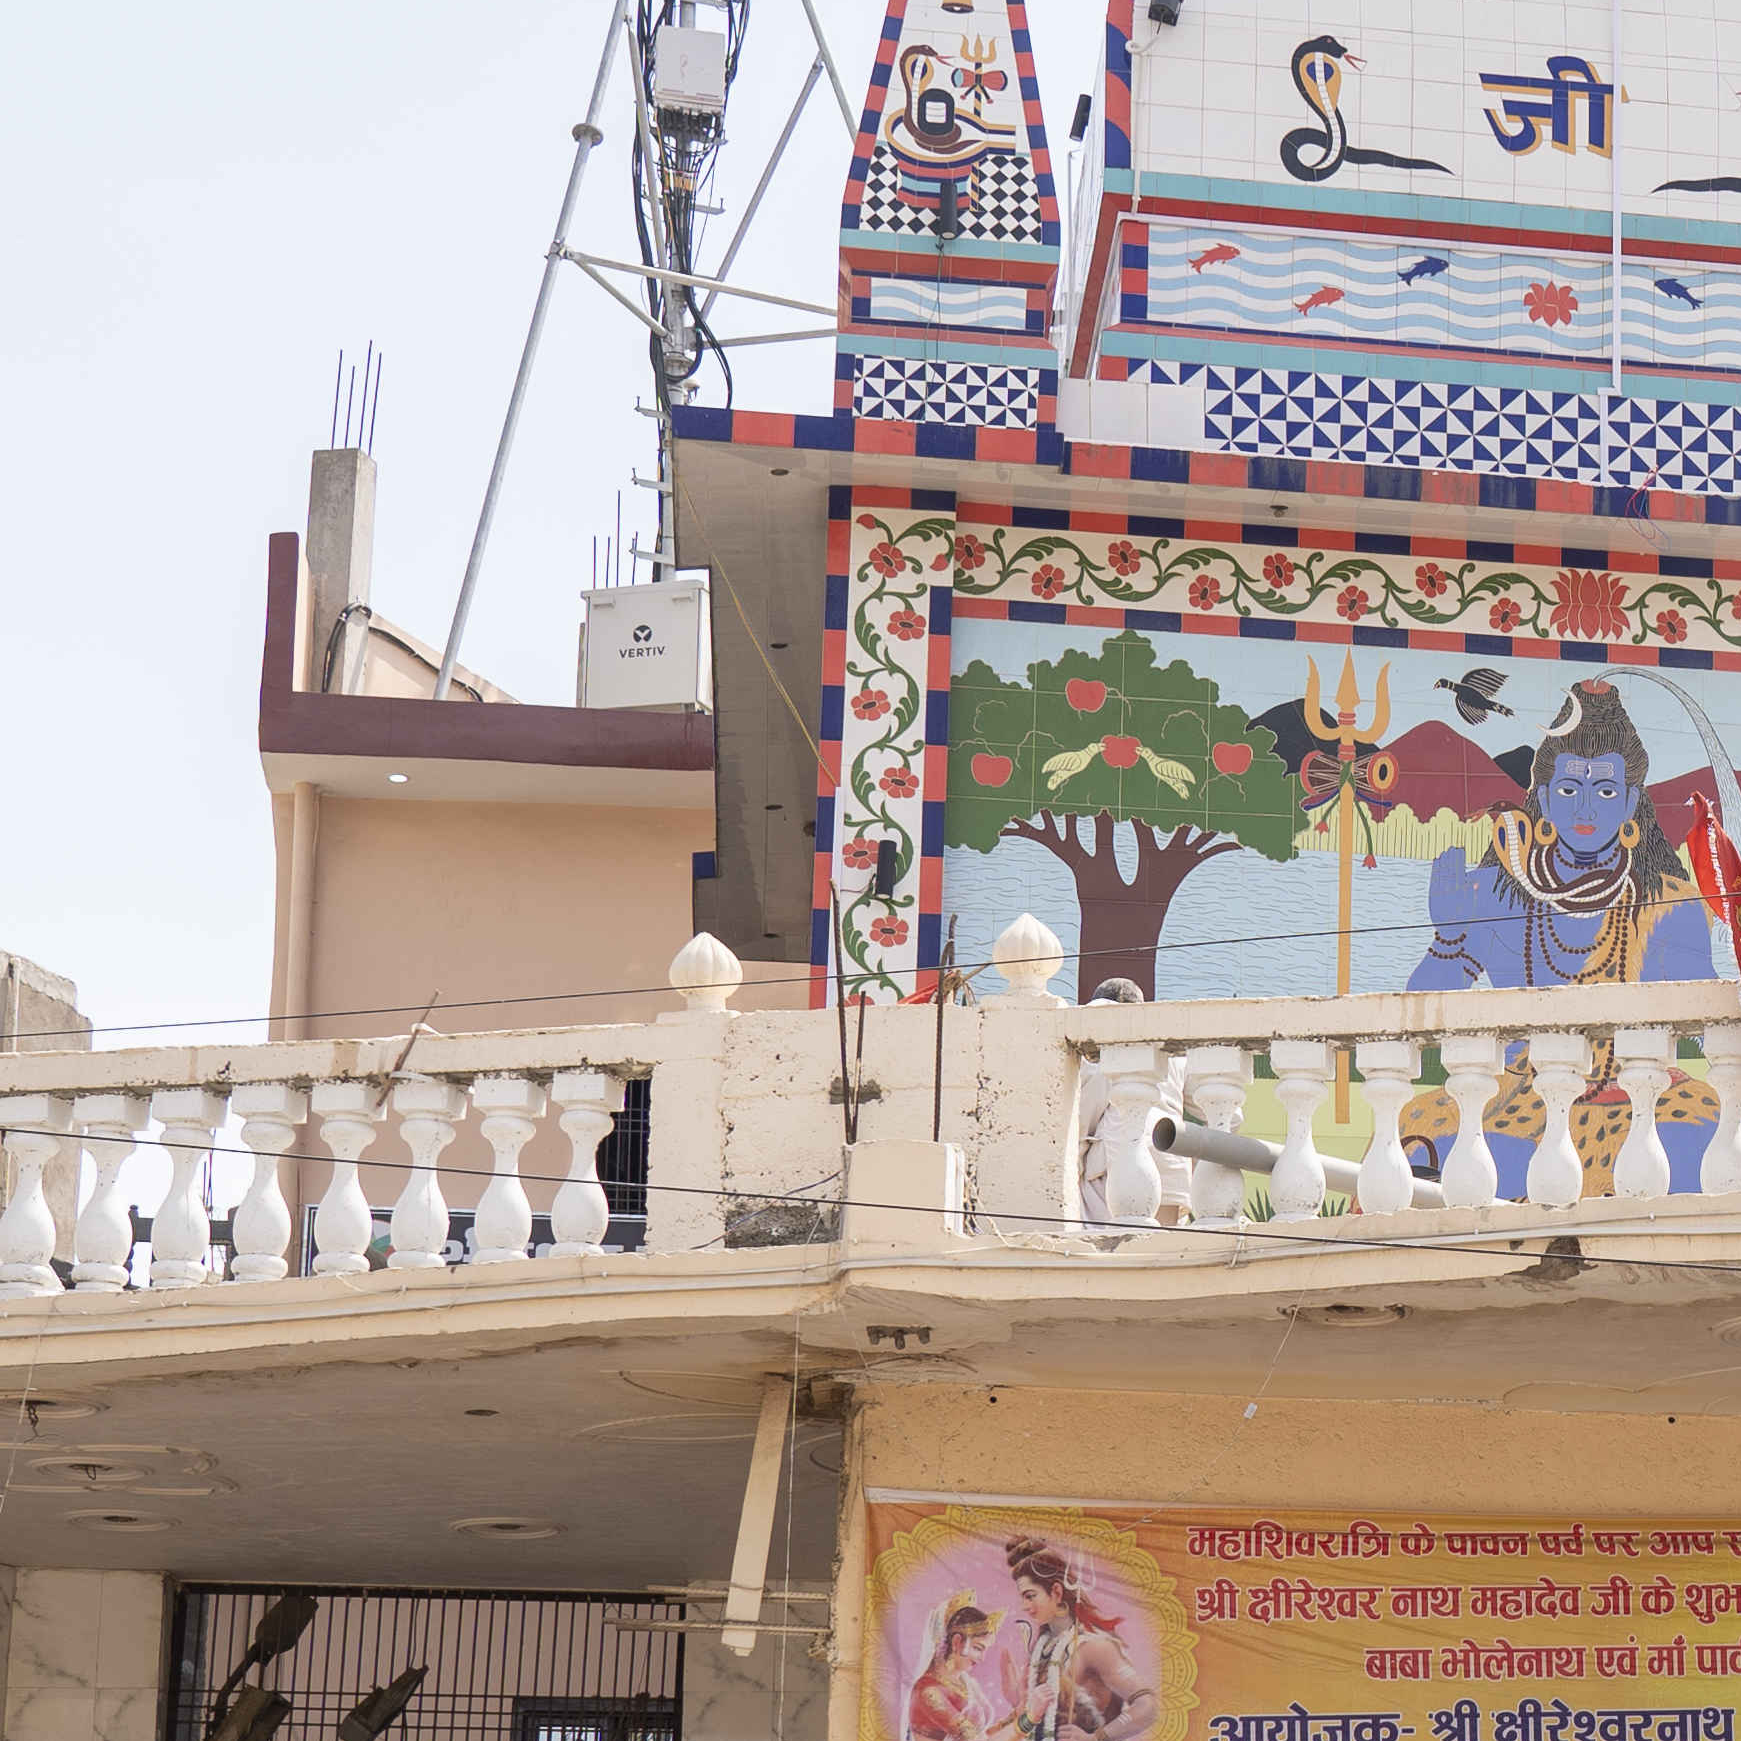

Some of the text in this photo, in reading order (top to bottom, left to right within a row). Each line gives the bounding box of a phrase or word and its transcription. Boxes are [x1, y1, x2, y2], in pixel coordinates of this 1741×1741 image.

[1479, 56, 1629, 159] जी
[619, 645, 667, 659] VERTIV
[1188, 1520, 1391, 1561] महाशिवरात्रि
[1399, 1523, 1435, 1557] के
[1445, 1531, 1529, 1557] पावन
[1538, 1523, 1583, 1557] पर्व
[1592, 1530, 1639, 1556] पर
[1649, 1531, 1716, 1556] आप
[1197, 1578, 1240, 1622] श्री
[1247, 1578, 1383, 1624] क्षीरेश्वर
[1391, 1586, 1462, 1618] नाथ
[1470, 1576, 1582, 1620] महादेव
[1590, 1575, 1632, 1616] जी
[1640, 1577, 1675, 1615] के
[1364, 1647, 1432, 1679] बाबा
[1441, 1638, 1586, 1679] भोलेनाथ
[1594, 1636, 1639, 1678] एवं
[1647, 1635, 1686, 1677] माँ
